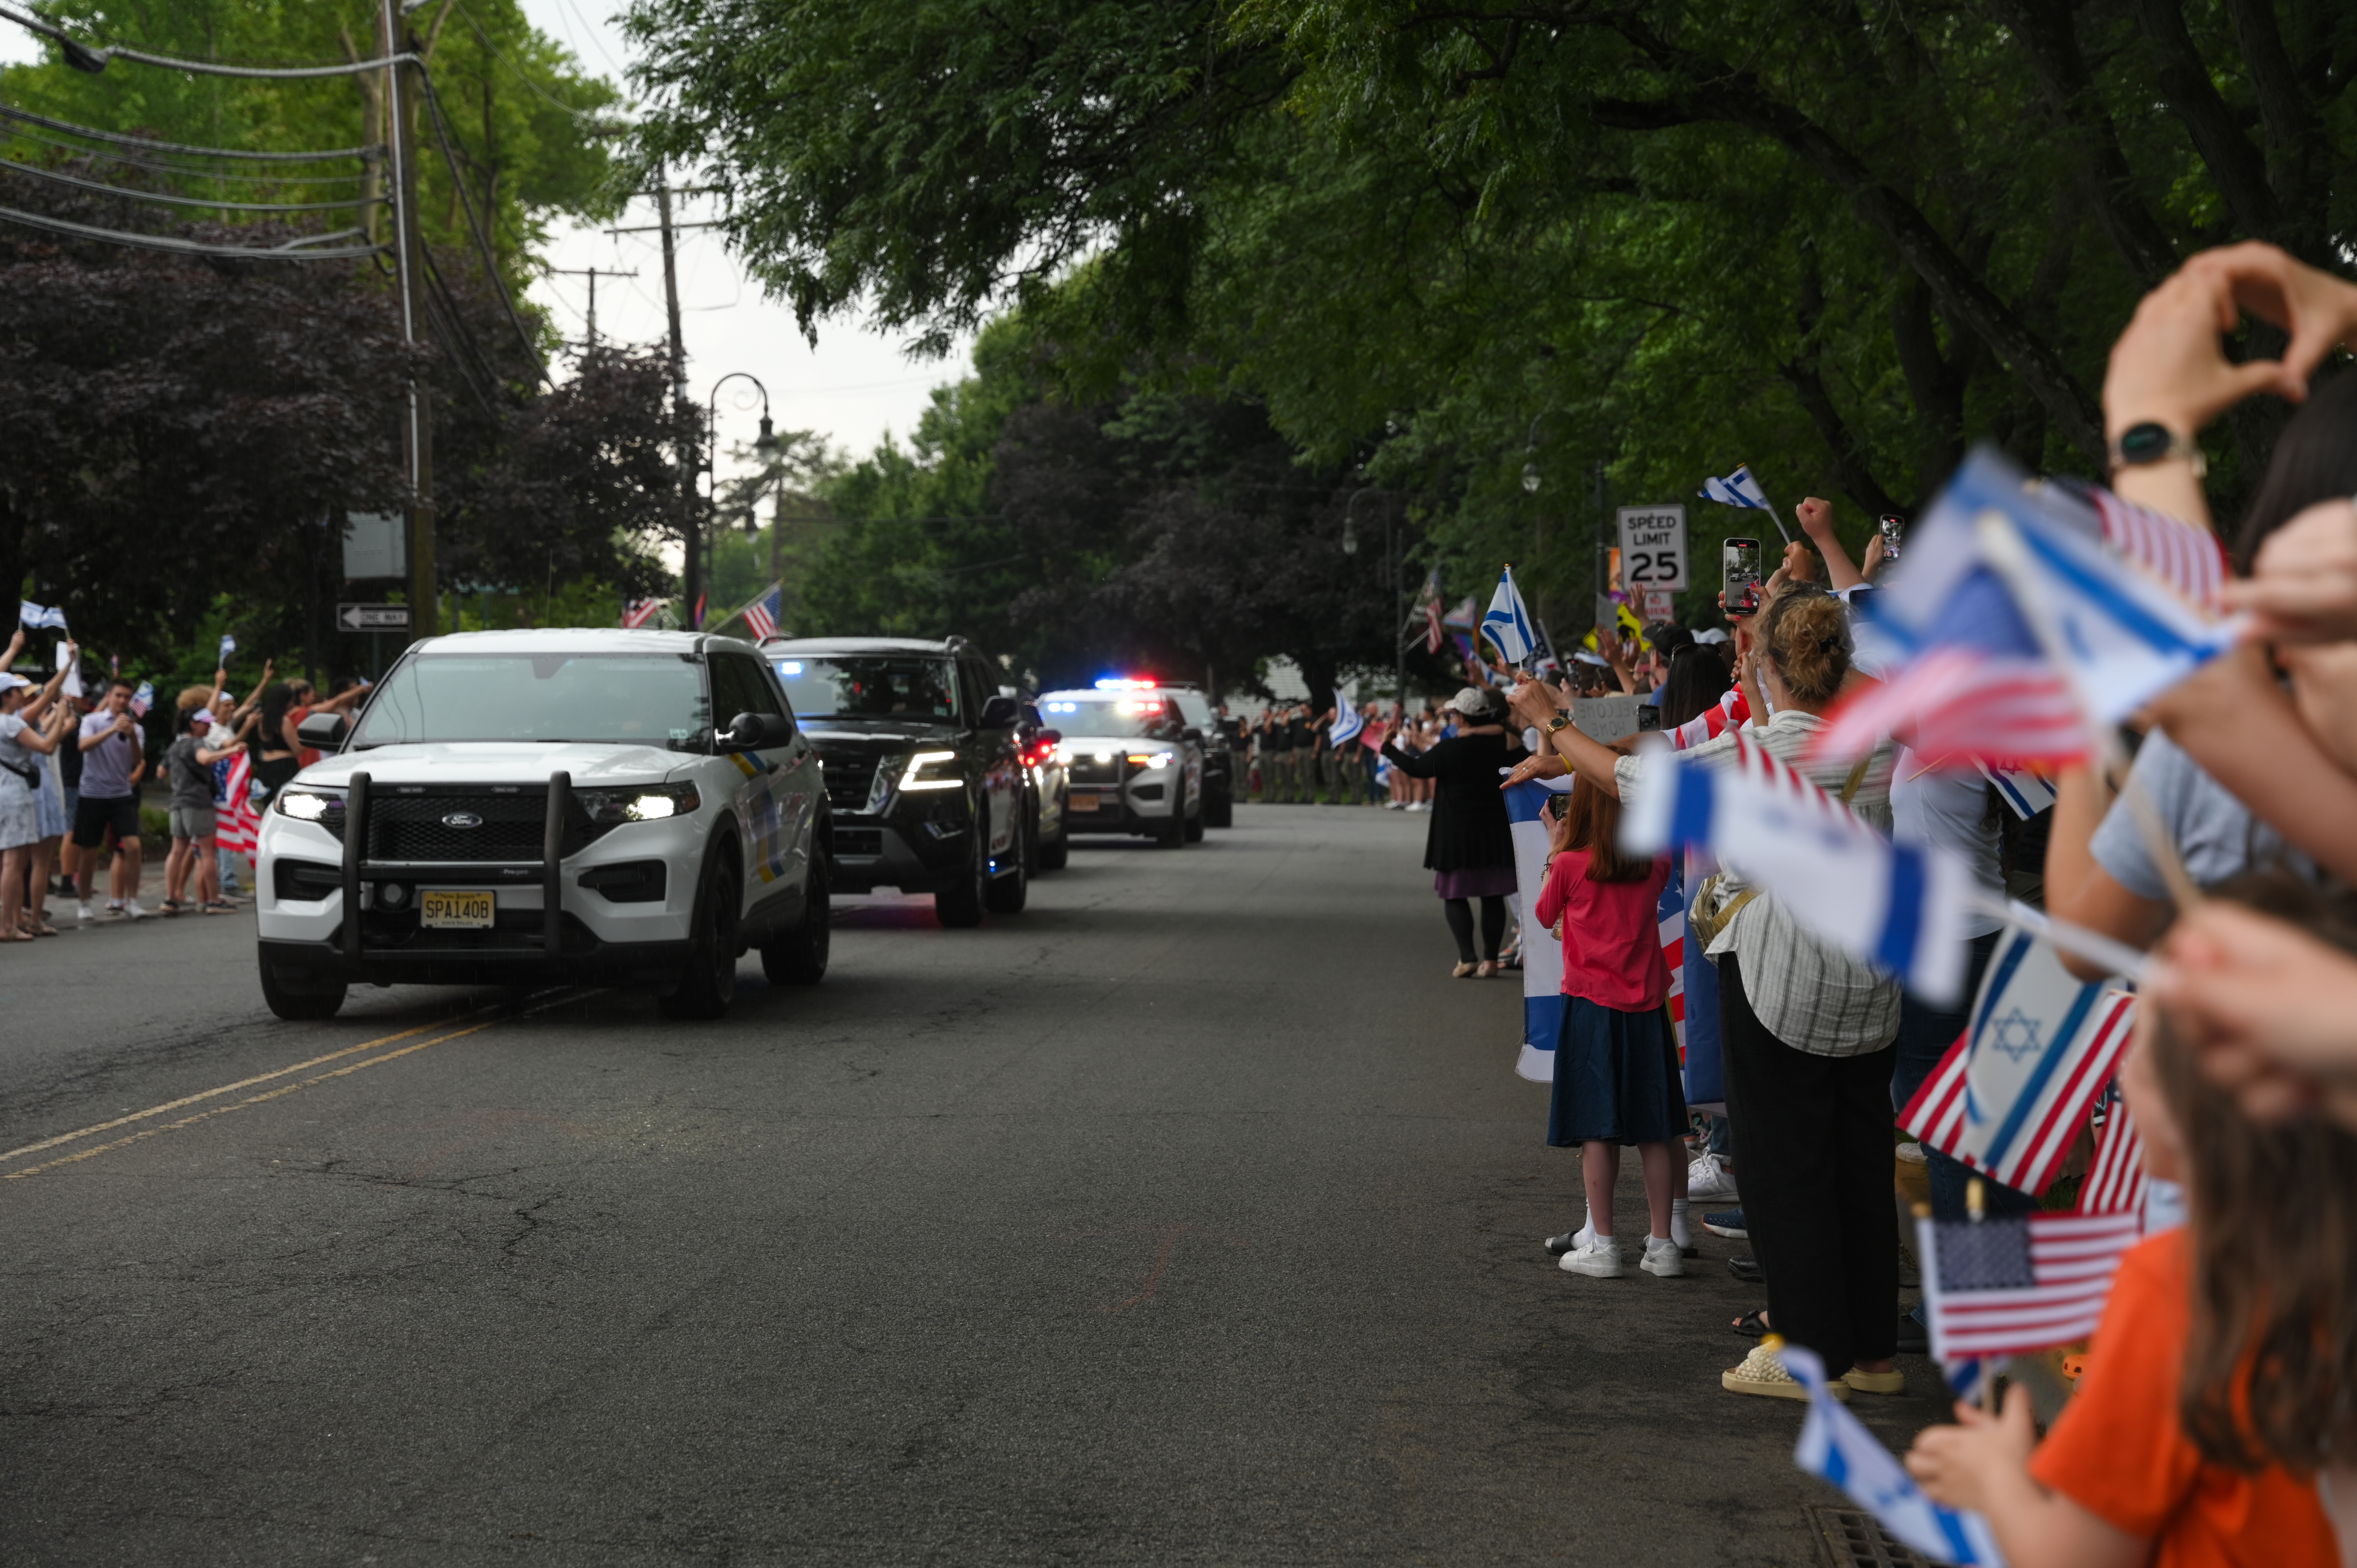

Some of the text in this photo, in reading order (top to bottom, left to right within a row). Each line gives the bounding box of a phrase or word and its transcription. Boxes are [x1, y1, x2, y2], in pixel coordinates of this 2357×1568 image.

[1628, 515, 1677, 530] SPEED
[1633, 532, 1670, 546] LIMIT
[1631, 552, 1679, 581] 25
[1649, 596, 1661, 605] NO
[362, 611, 405, 623] ONE WAY
[1645, 606, 1671, 616] ARKING
[451, 814, 473, 825] Ford
[426, 900, 488, 918] SPA140B
